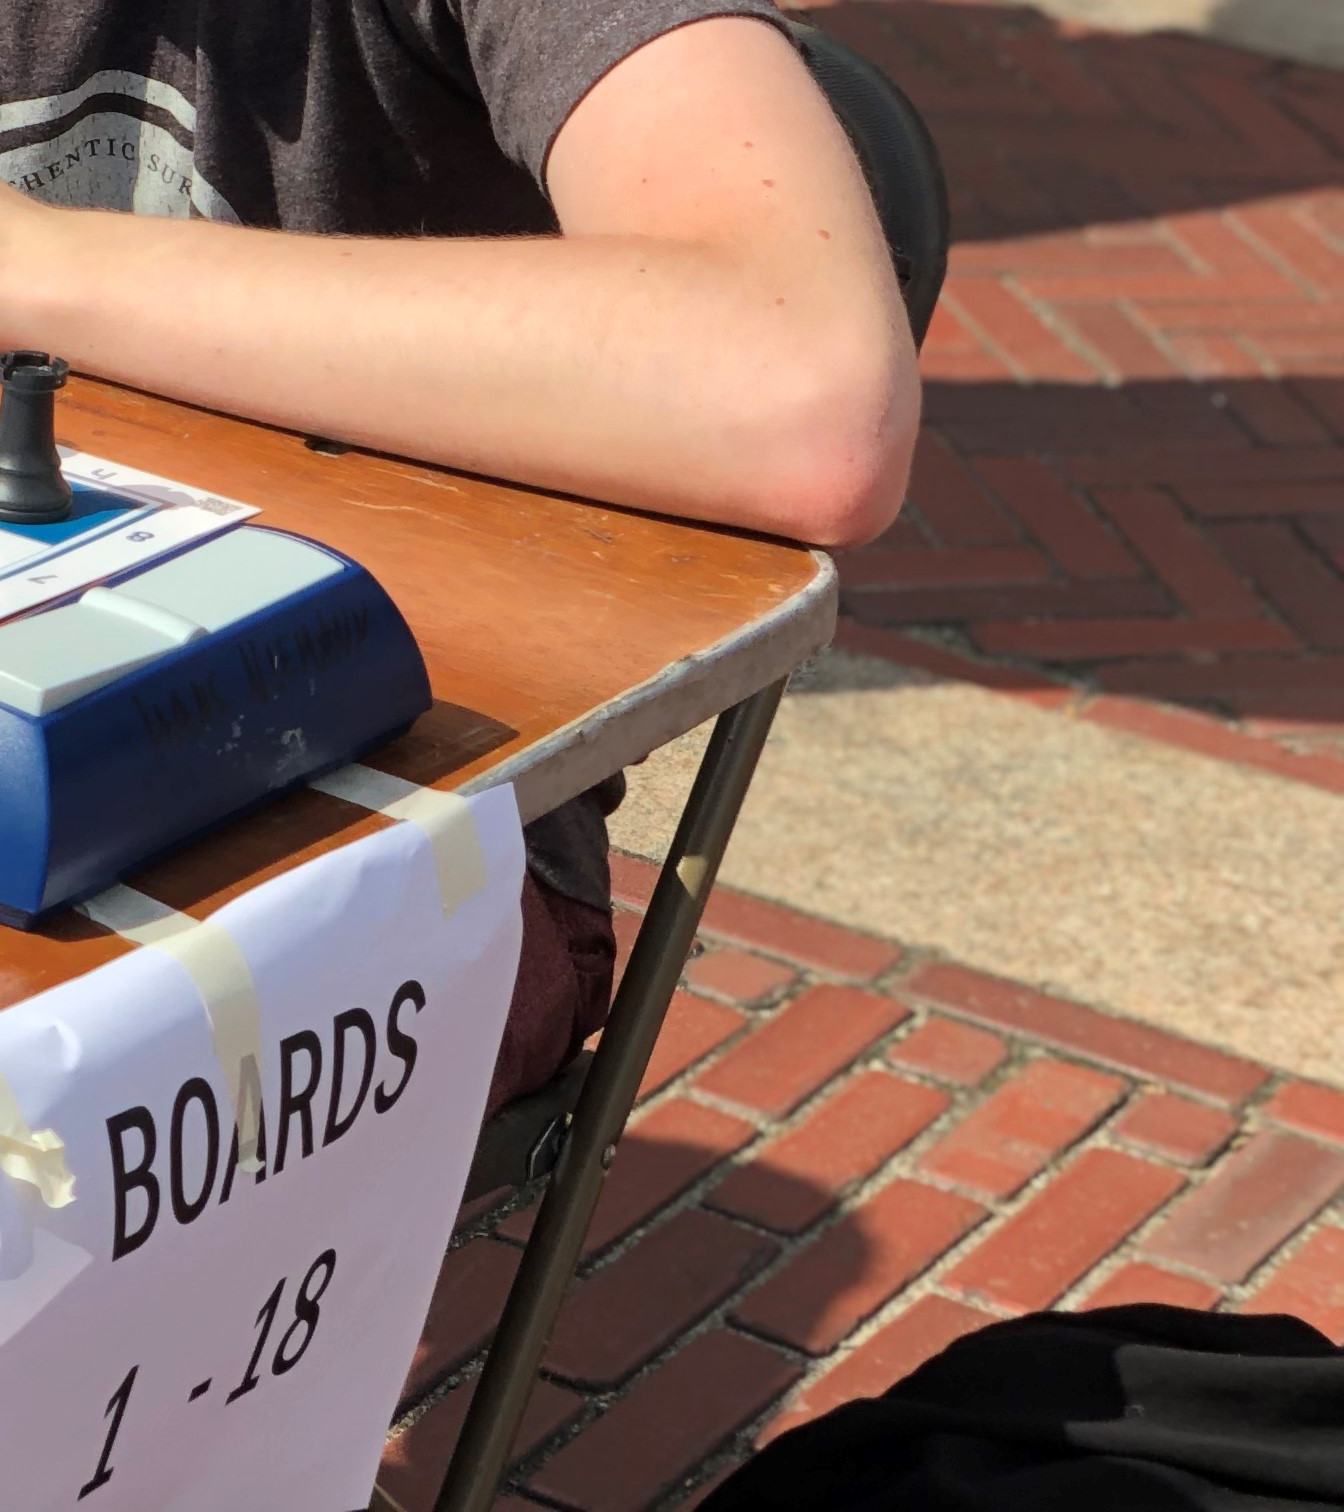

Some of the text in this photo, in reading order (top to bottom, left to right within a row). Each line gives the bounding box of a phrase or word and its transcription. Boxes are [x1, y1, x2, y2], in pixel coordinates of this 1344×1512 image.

[125, 531, 155, 543] 8
[106, 978, 426, 1261] BOARDS
[77, 1364, 140, 1501] 1
